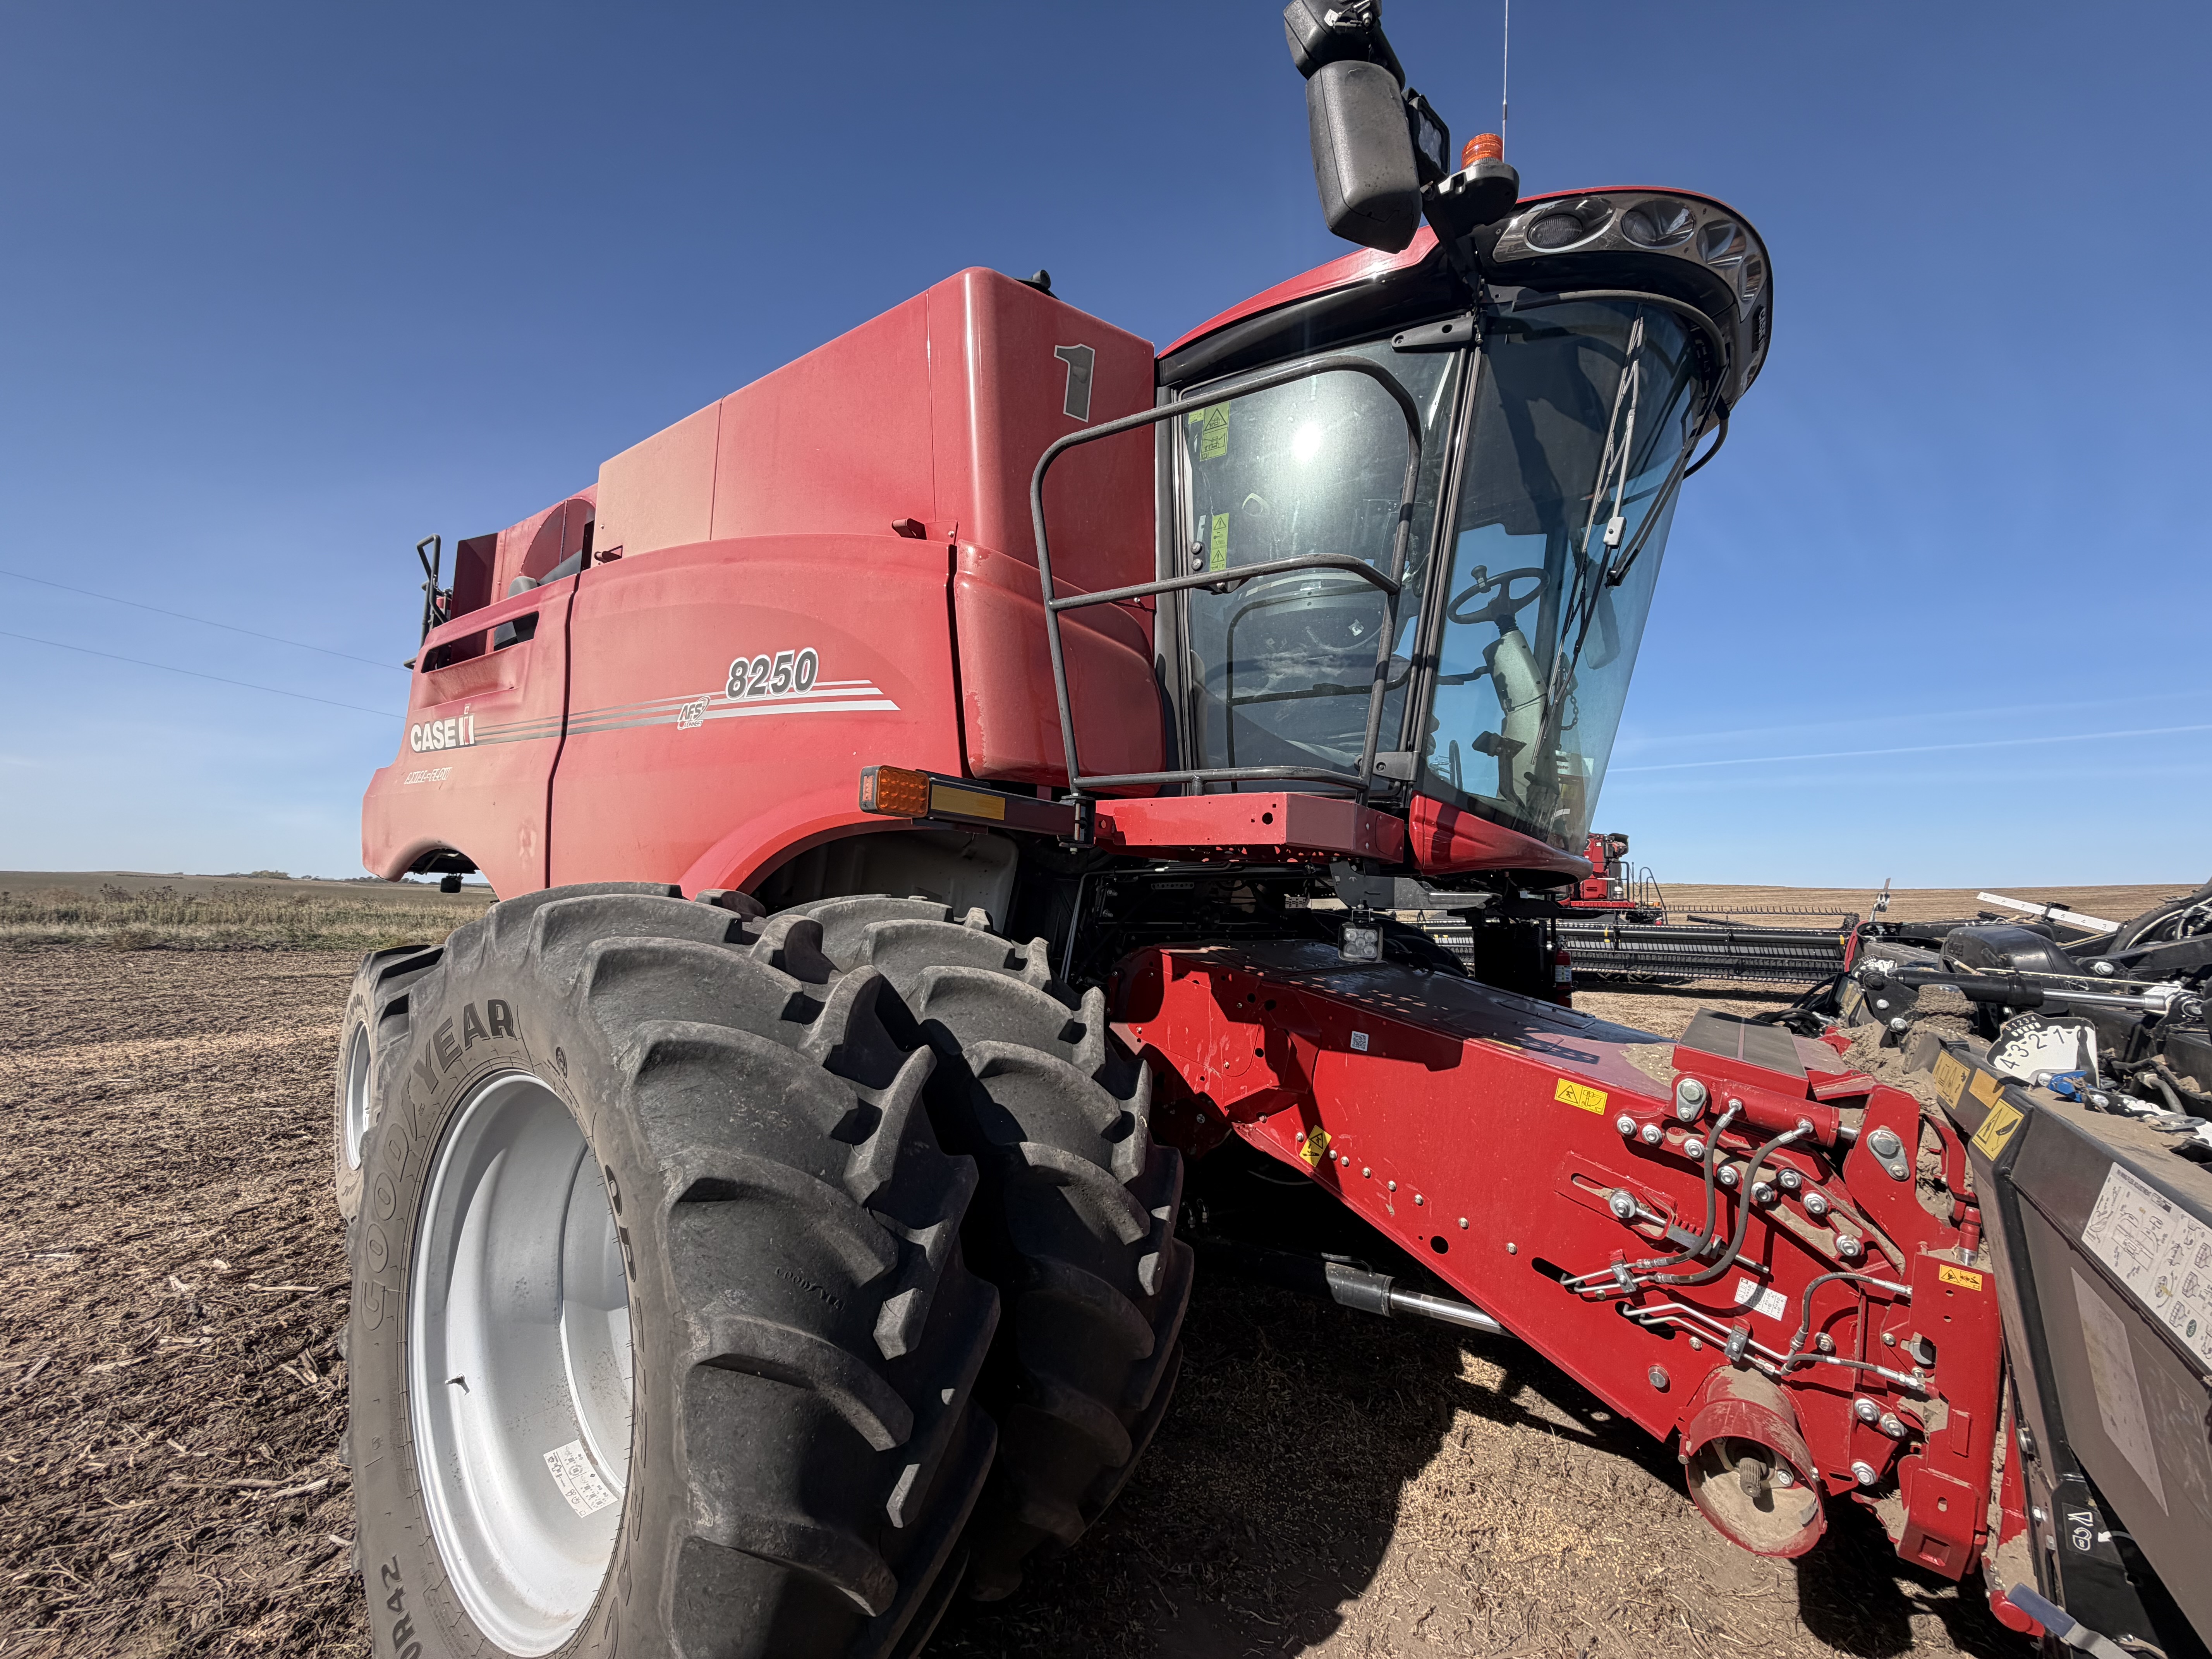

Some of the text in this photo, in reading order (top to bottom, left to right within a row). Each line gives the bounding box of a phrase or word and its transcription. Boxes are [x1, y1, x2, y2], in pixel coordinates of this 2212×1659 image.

[1054, 343, 1095, 422] 1
[725, 647, 818, 700] 8250
[678, 701, 704, 721] AFS
[410, 719, 456, 752] CASE
[404, 767, 453, 785] AXIAL-FLOW
[1999, 1058, 2020, 1070] 4
[2010, 1044, 2029, 1057] 3
[2028, 1034, 2048, 1049] 2
[2053, 1028, 2064, 1044] 1
[361, 998, 519, 1331] GOODYEAR
